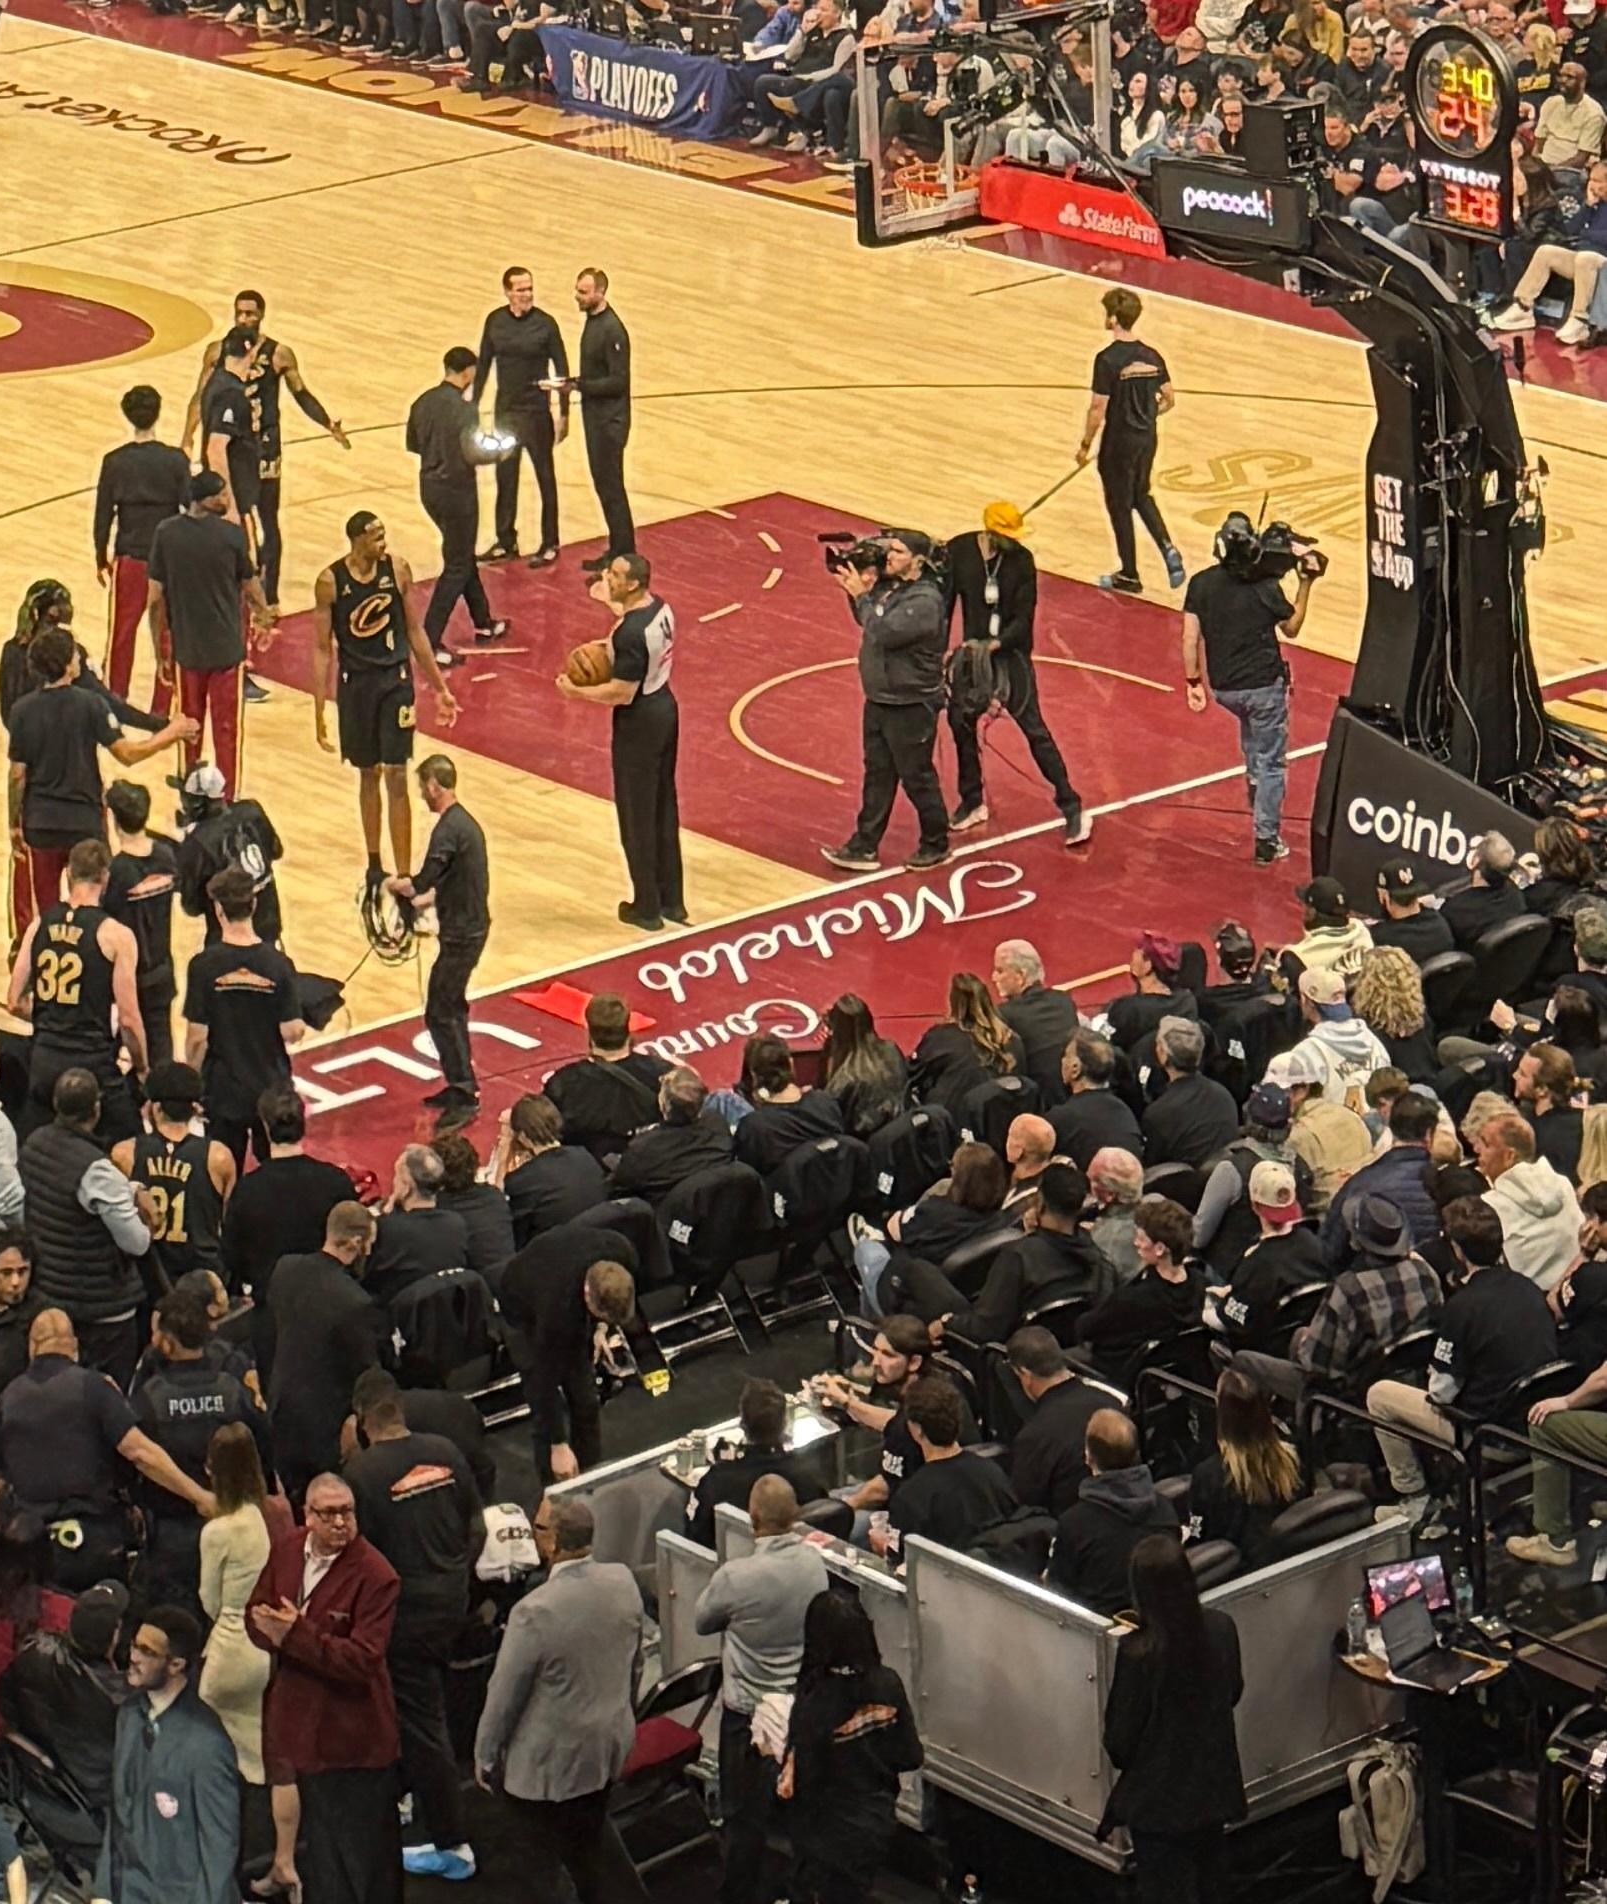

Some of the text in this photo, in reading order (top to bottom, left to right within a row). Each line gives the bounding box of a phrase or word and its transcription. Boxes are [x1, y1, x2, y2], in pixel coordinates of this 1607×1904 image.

[591, 53, 679, 121] PLAYOFFS
[1439, 61, 1496, 102] 3:40
[1435, 95, 1488, 146] 24
[1440, 163, 1502, 191] TISSOT
[1183, 185, 1267, 219] peacock
[639, 859, 1037, 1003] Michelob
[36, 948, 84, 1005] 32
[168, 1394, 225, 1417] POLICE
